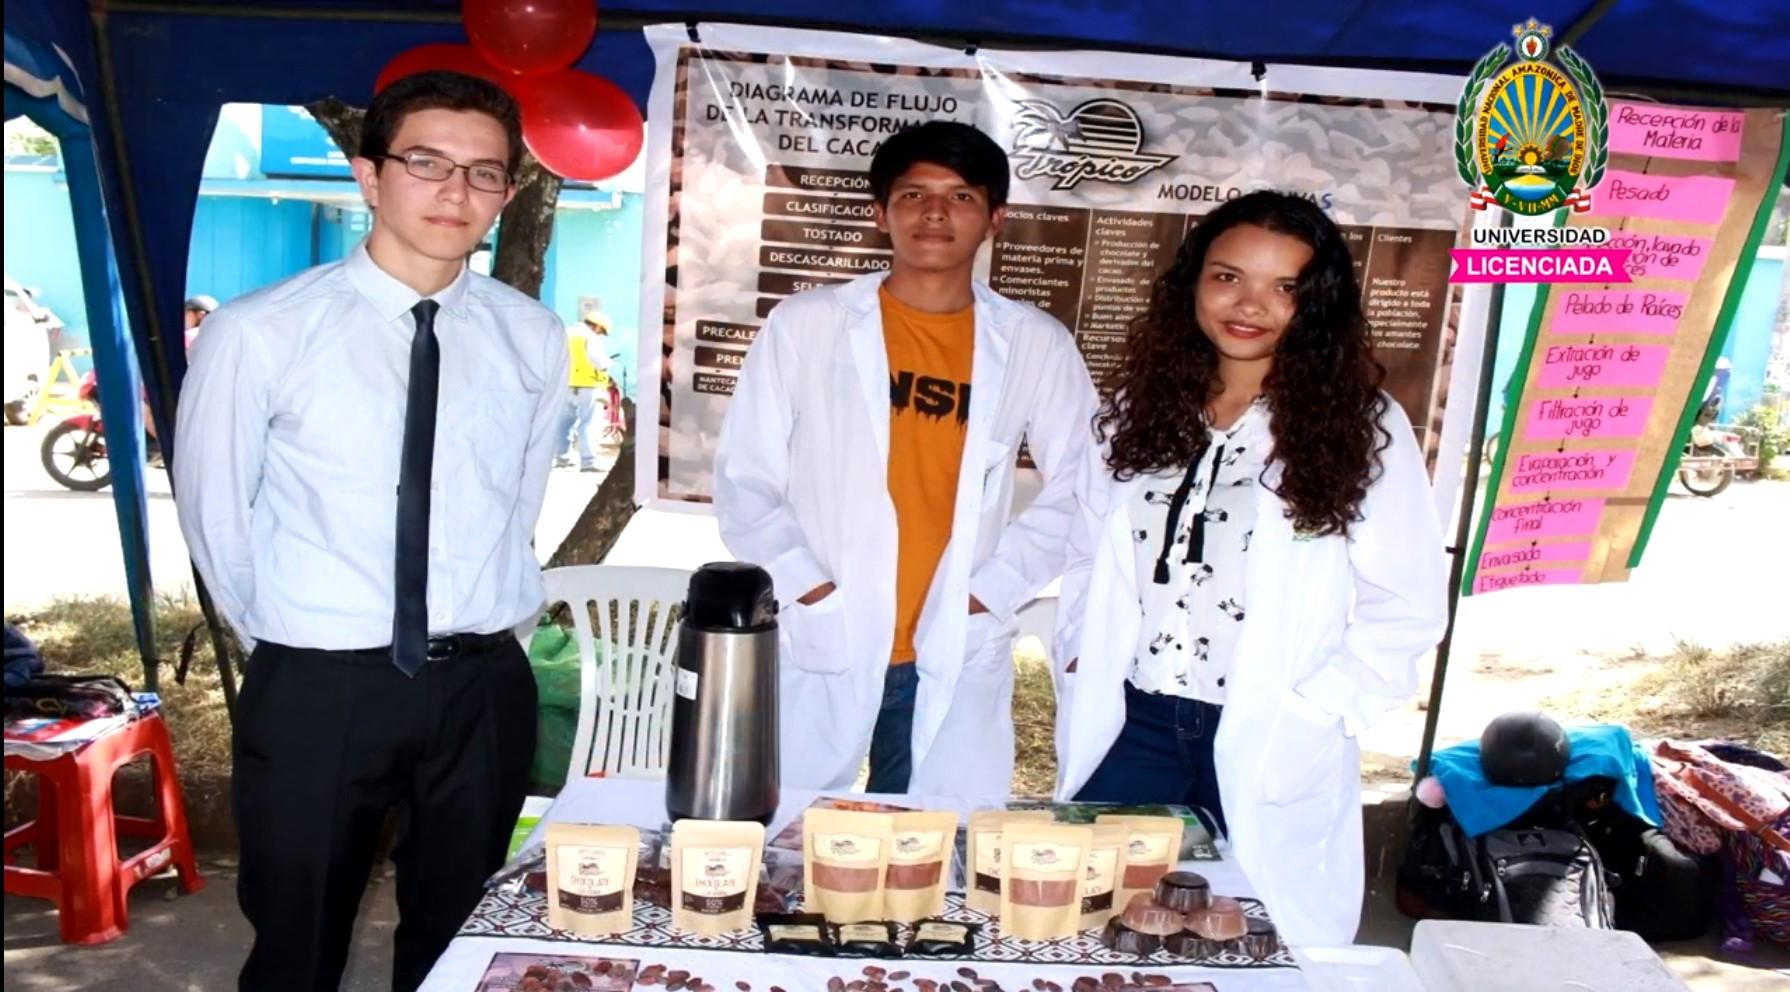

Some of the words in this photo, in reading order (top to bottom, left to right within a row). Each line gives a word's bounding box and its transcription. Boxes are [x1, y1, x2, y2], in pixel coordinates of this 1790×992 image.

[730, 81, 843, 107] DIAGRAMA
[851, 91, 878, 109] DE
[887, 94, 957, 114] FLUJO
[706, 104, 734, 122] DE
[1617, 106, 1706, 131] Recepción
[1712, 115, 1728, 133] de
[1730, 116, 1741, 133] la
[778, 134, 818, 153] DEL
[827, 138, 882, 157] CACA
[1643, 130, 1703, 150] Materia
[1157, 184, 1241, 203] MODELO
[1609, 180, 1670, 201] Pesado
[786, 201, 874, 217] CLASIFICACIÓ
[1006, 211, 1034, 220] ocios
[1036, 212, 1069, 222] claves
[1097, 216, 1153, 227] Actividades
[803, 228, 863, 242] TOSTADO
[1095, 227, 1126, 236] claves
[1378, 234, 1412, 243] Clientes
[1002, 241, 1067, 254] Proveedores
[1070, 247, 1083, 255] de
[1652, 235, 1701, 256] lavado
[770, 252, 890, 270] DESCASCARILLADO
[1001, 254, 1042, 263] materia
[1044, 256, 1074, 267] prima
[1077, 260, 1084, 268] y
[1660, 254, 1679, 267] de
[1000, 265, 1044, 274] envases.
[1000, 275, 1069, 287] Comerciantes
[1372, 278, 1406, 287] Nuestro
[999, 287, 1051, 297] minoristas
[1370, 289, 1409, 298] producto
[1038, 300, 1051, 308] de
[1368, 299, 1401, 308] dirigido
[1411, 300, 1430, 308] toda
[1565, 293, 1612, 315] Pelado
[1616, 294, 1634, 315] de
[1641, 294, 1683, 320] Raíces
[1083, 333, 1126, 342] Recursos
[1376, 340, 1420, 348] chocolate
[1081, 342, 1107, 350] clave
[1621, 345, 1640, 362] de
[1566, 365, 1601, 381] jugo
[1539, 400, 1604, 421] Filtración
[1608, 398, 1629, 418] de
[1565, 417, 1601, 437] jugo
[1606, 455, 1617, 467] y
[1512, 467, 1604, 487] concentración
[1481, 546, 1541, 569] Envasado
